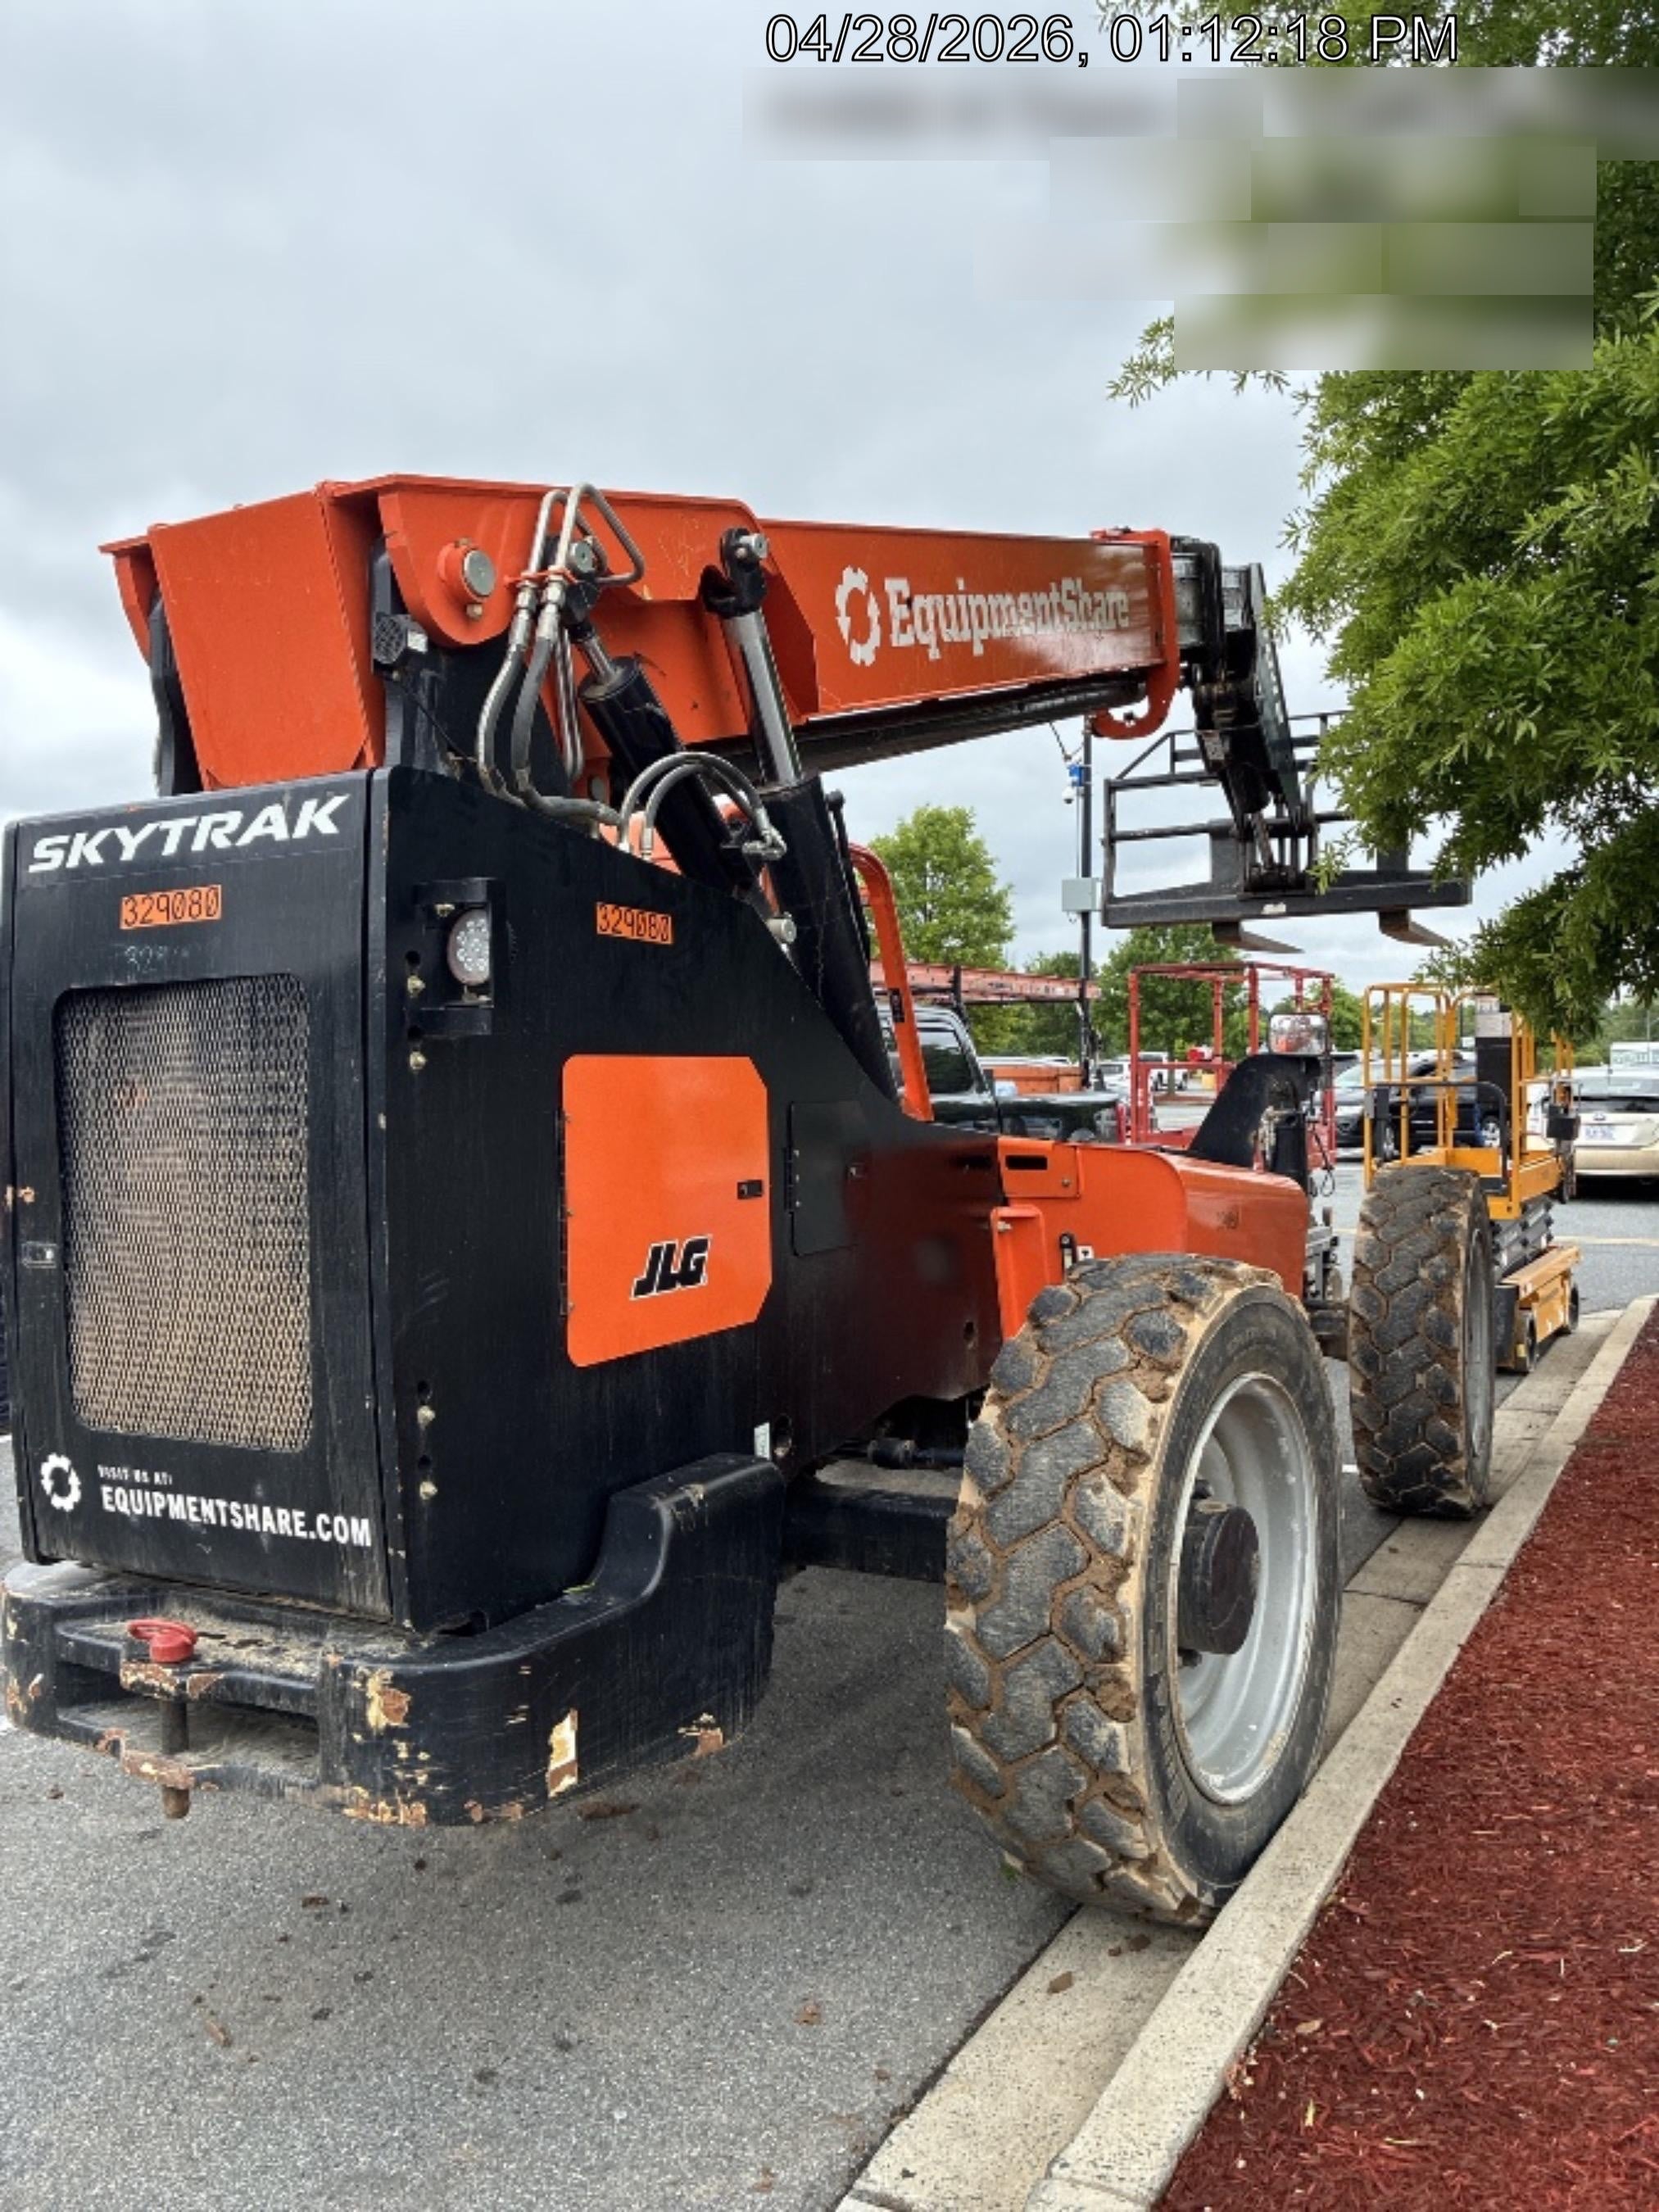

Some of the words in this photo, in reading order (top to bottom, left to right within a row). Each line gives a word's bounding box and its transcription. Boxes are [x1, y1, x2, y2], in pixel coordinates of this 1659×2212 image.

[884, 577, 1130, 660] EquipmentShare
[28, 793, 351, 873] SKYTRAK
[123, 886, 220, 927] 329080
[598, 903, 670, 942] 329080
[630, 1235, 712, 1300] JLG
[100, 1484, 372, 1548] EQUIPMENTSHARE.COM
